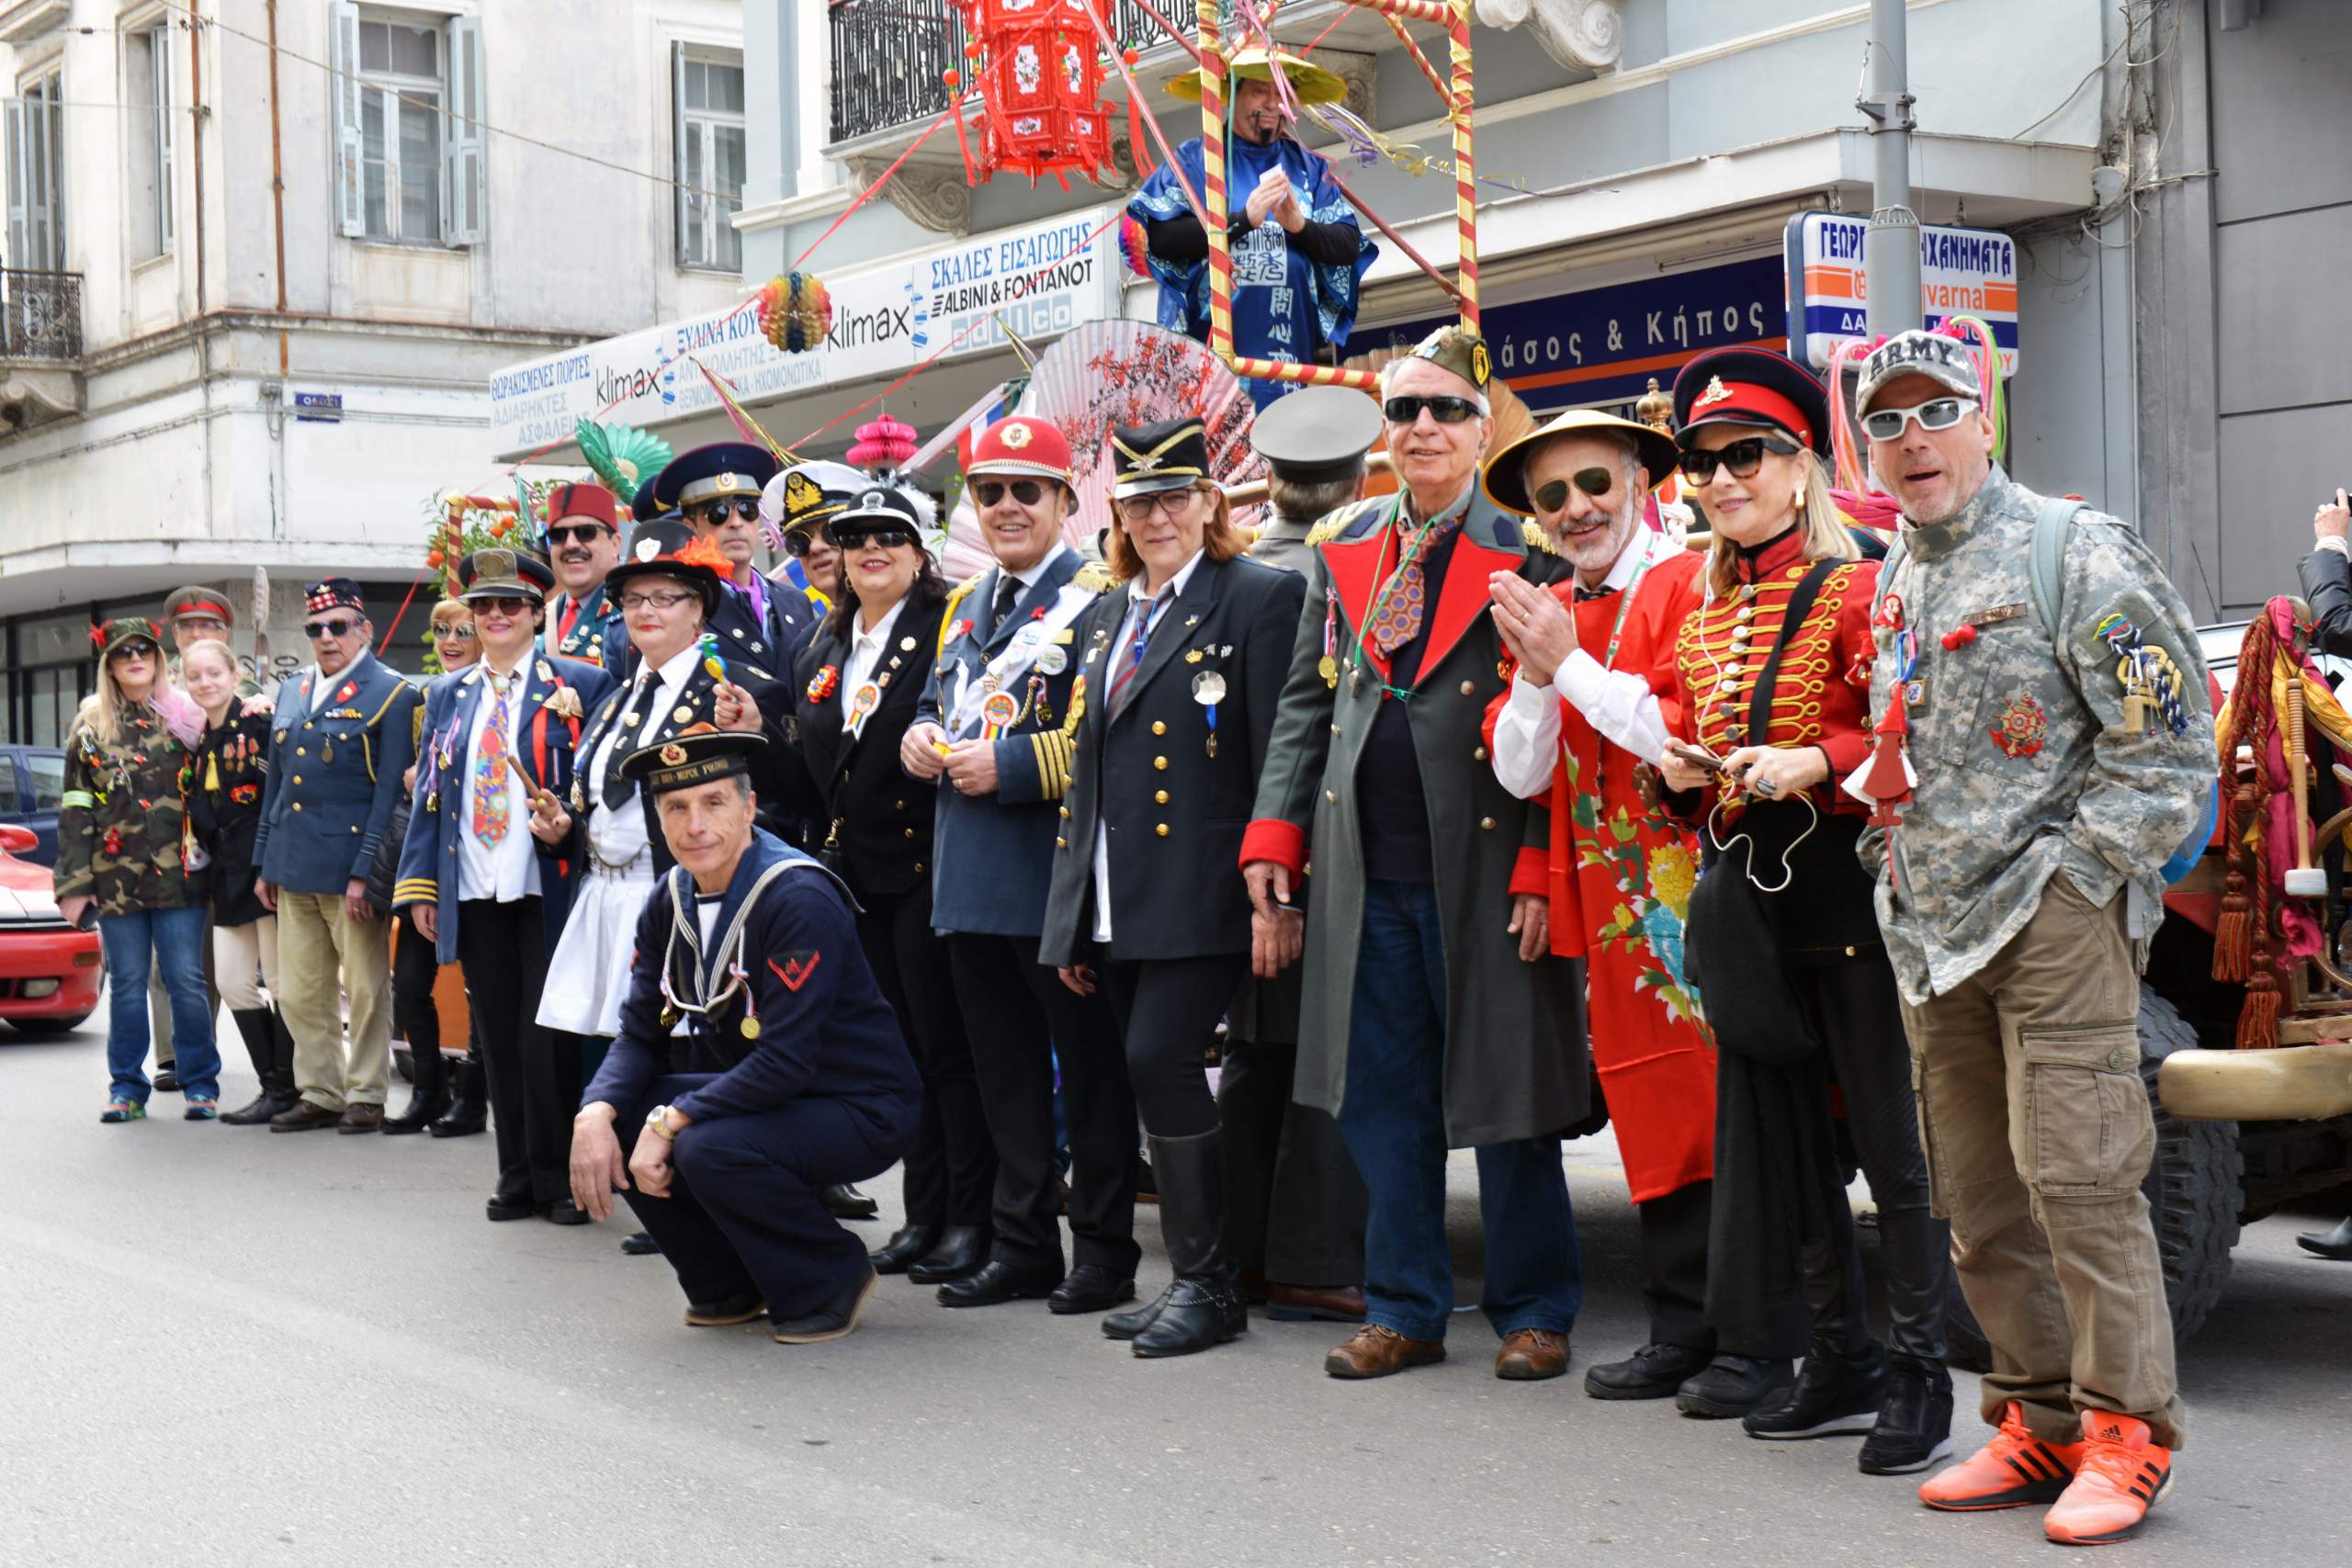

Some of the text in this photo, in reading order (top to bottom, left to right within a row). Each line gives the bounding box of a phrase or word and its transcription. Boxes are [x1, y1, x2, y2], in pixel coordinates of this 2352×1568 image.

[932, 221, 1093, 290] ΣΚΑΛΕΣ ΕΙΣΑΓΩΓΗΣ
[1820, 221, 1867, 263] ΓΕΩΡΓ
[943, 259, 1093, 316] ALBINI & FONTANOT
[1923, 283, 1984, 311] varna
[729, 310, 758, 341] ΚΟΥ
[827, 305, 910, 353] klimax
[1500, 301, 1765, 367] άσος & Κήπος
[492, 354, 591, 401] ΘΩΡΑΚΙΣΜΕΝΕΣ ΠΟΡΤΕΣ
[1870, 337, 1953, 381] ARMY
[595, 366, 661, 407] klimax
[493, 391, 568, 427] ΑΔΙΑΡΗΚΤΕΣ
